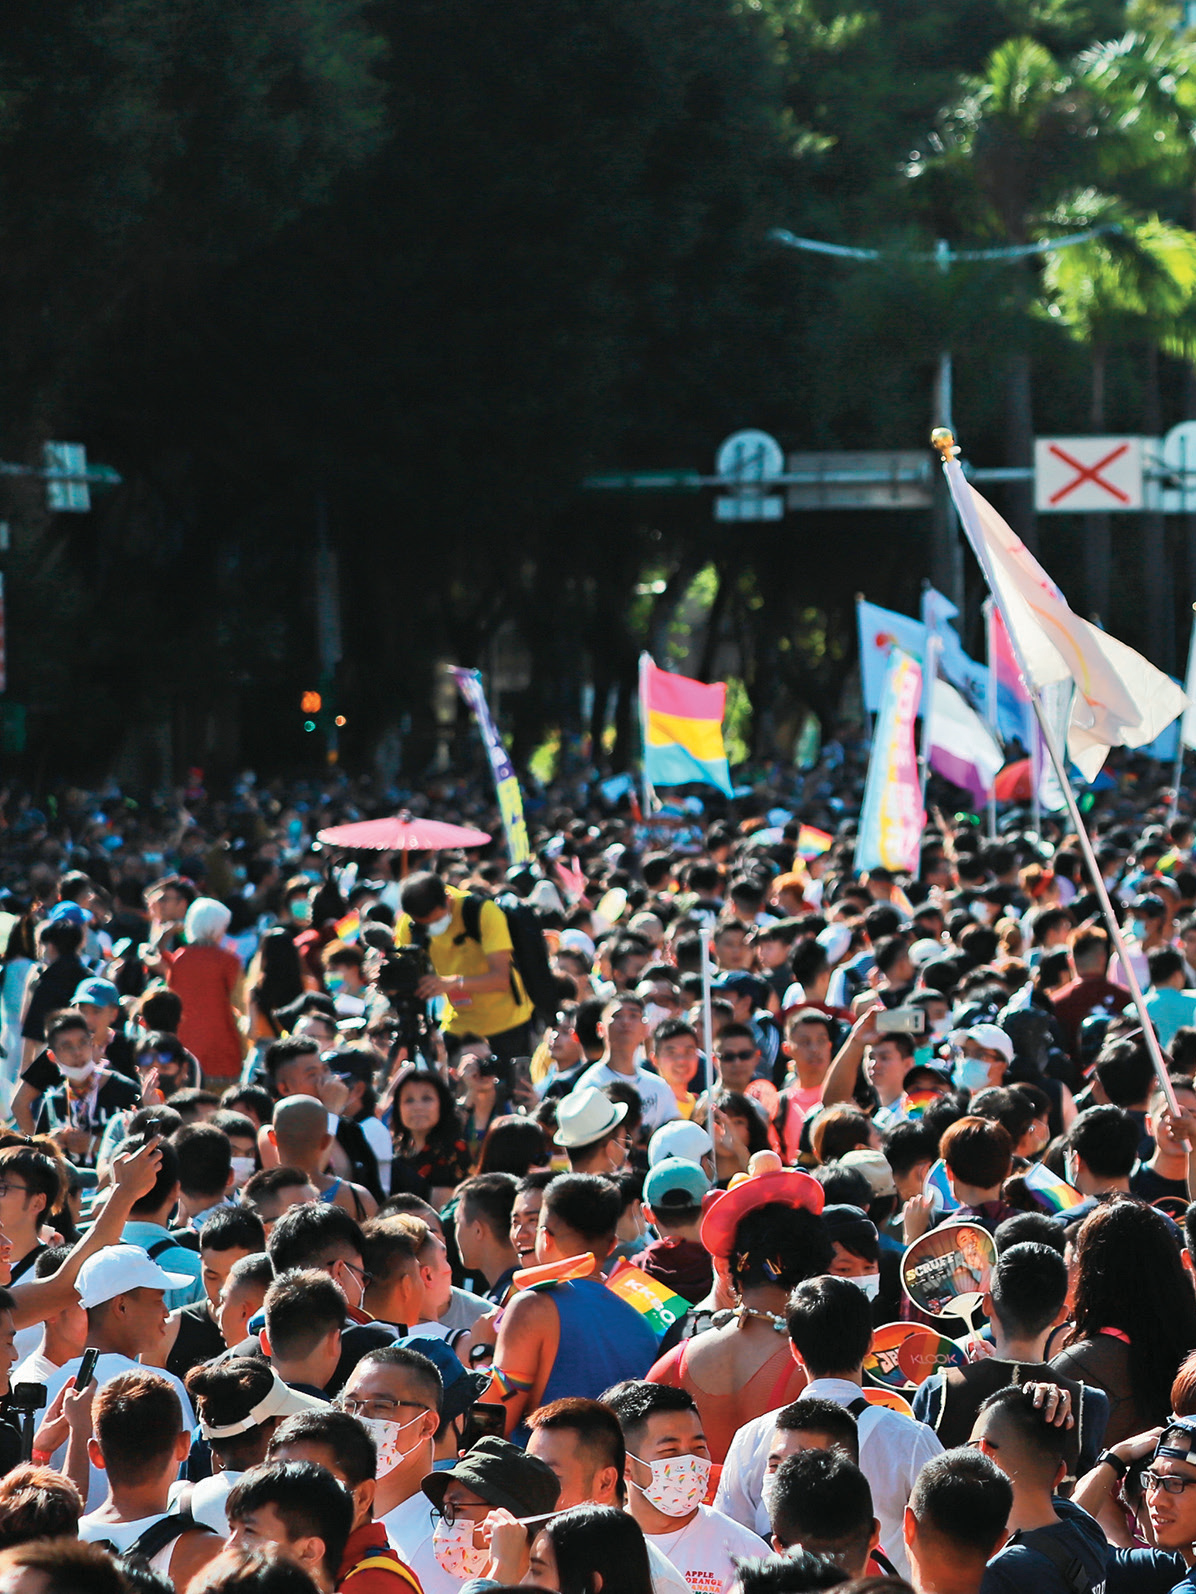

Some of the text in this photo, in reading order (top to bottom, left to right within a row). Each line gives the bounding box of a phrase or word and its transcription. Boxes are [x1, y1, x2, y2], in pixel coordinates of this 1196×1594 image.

[910, 1353, 958, 1365] KLOOK
[685, 1570, 714, 1579] APPLE
[685, 1577, 723, 1587] ORANGE
[691, 1584, 721, 1593] ANANA
